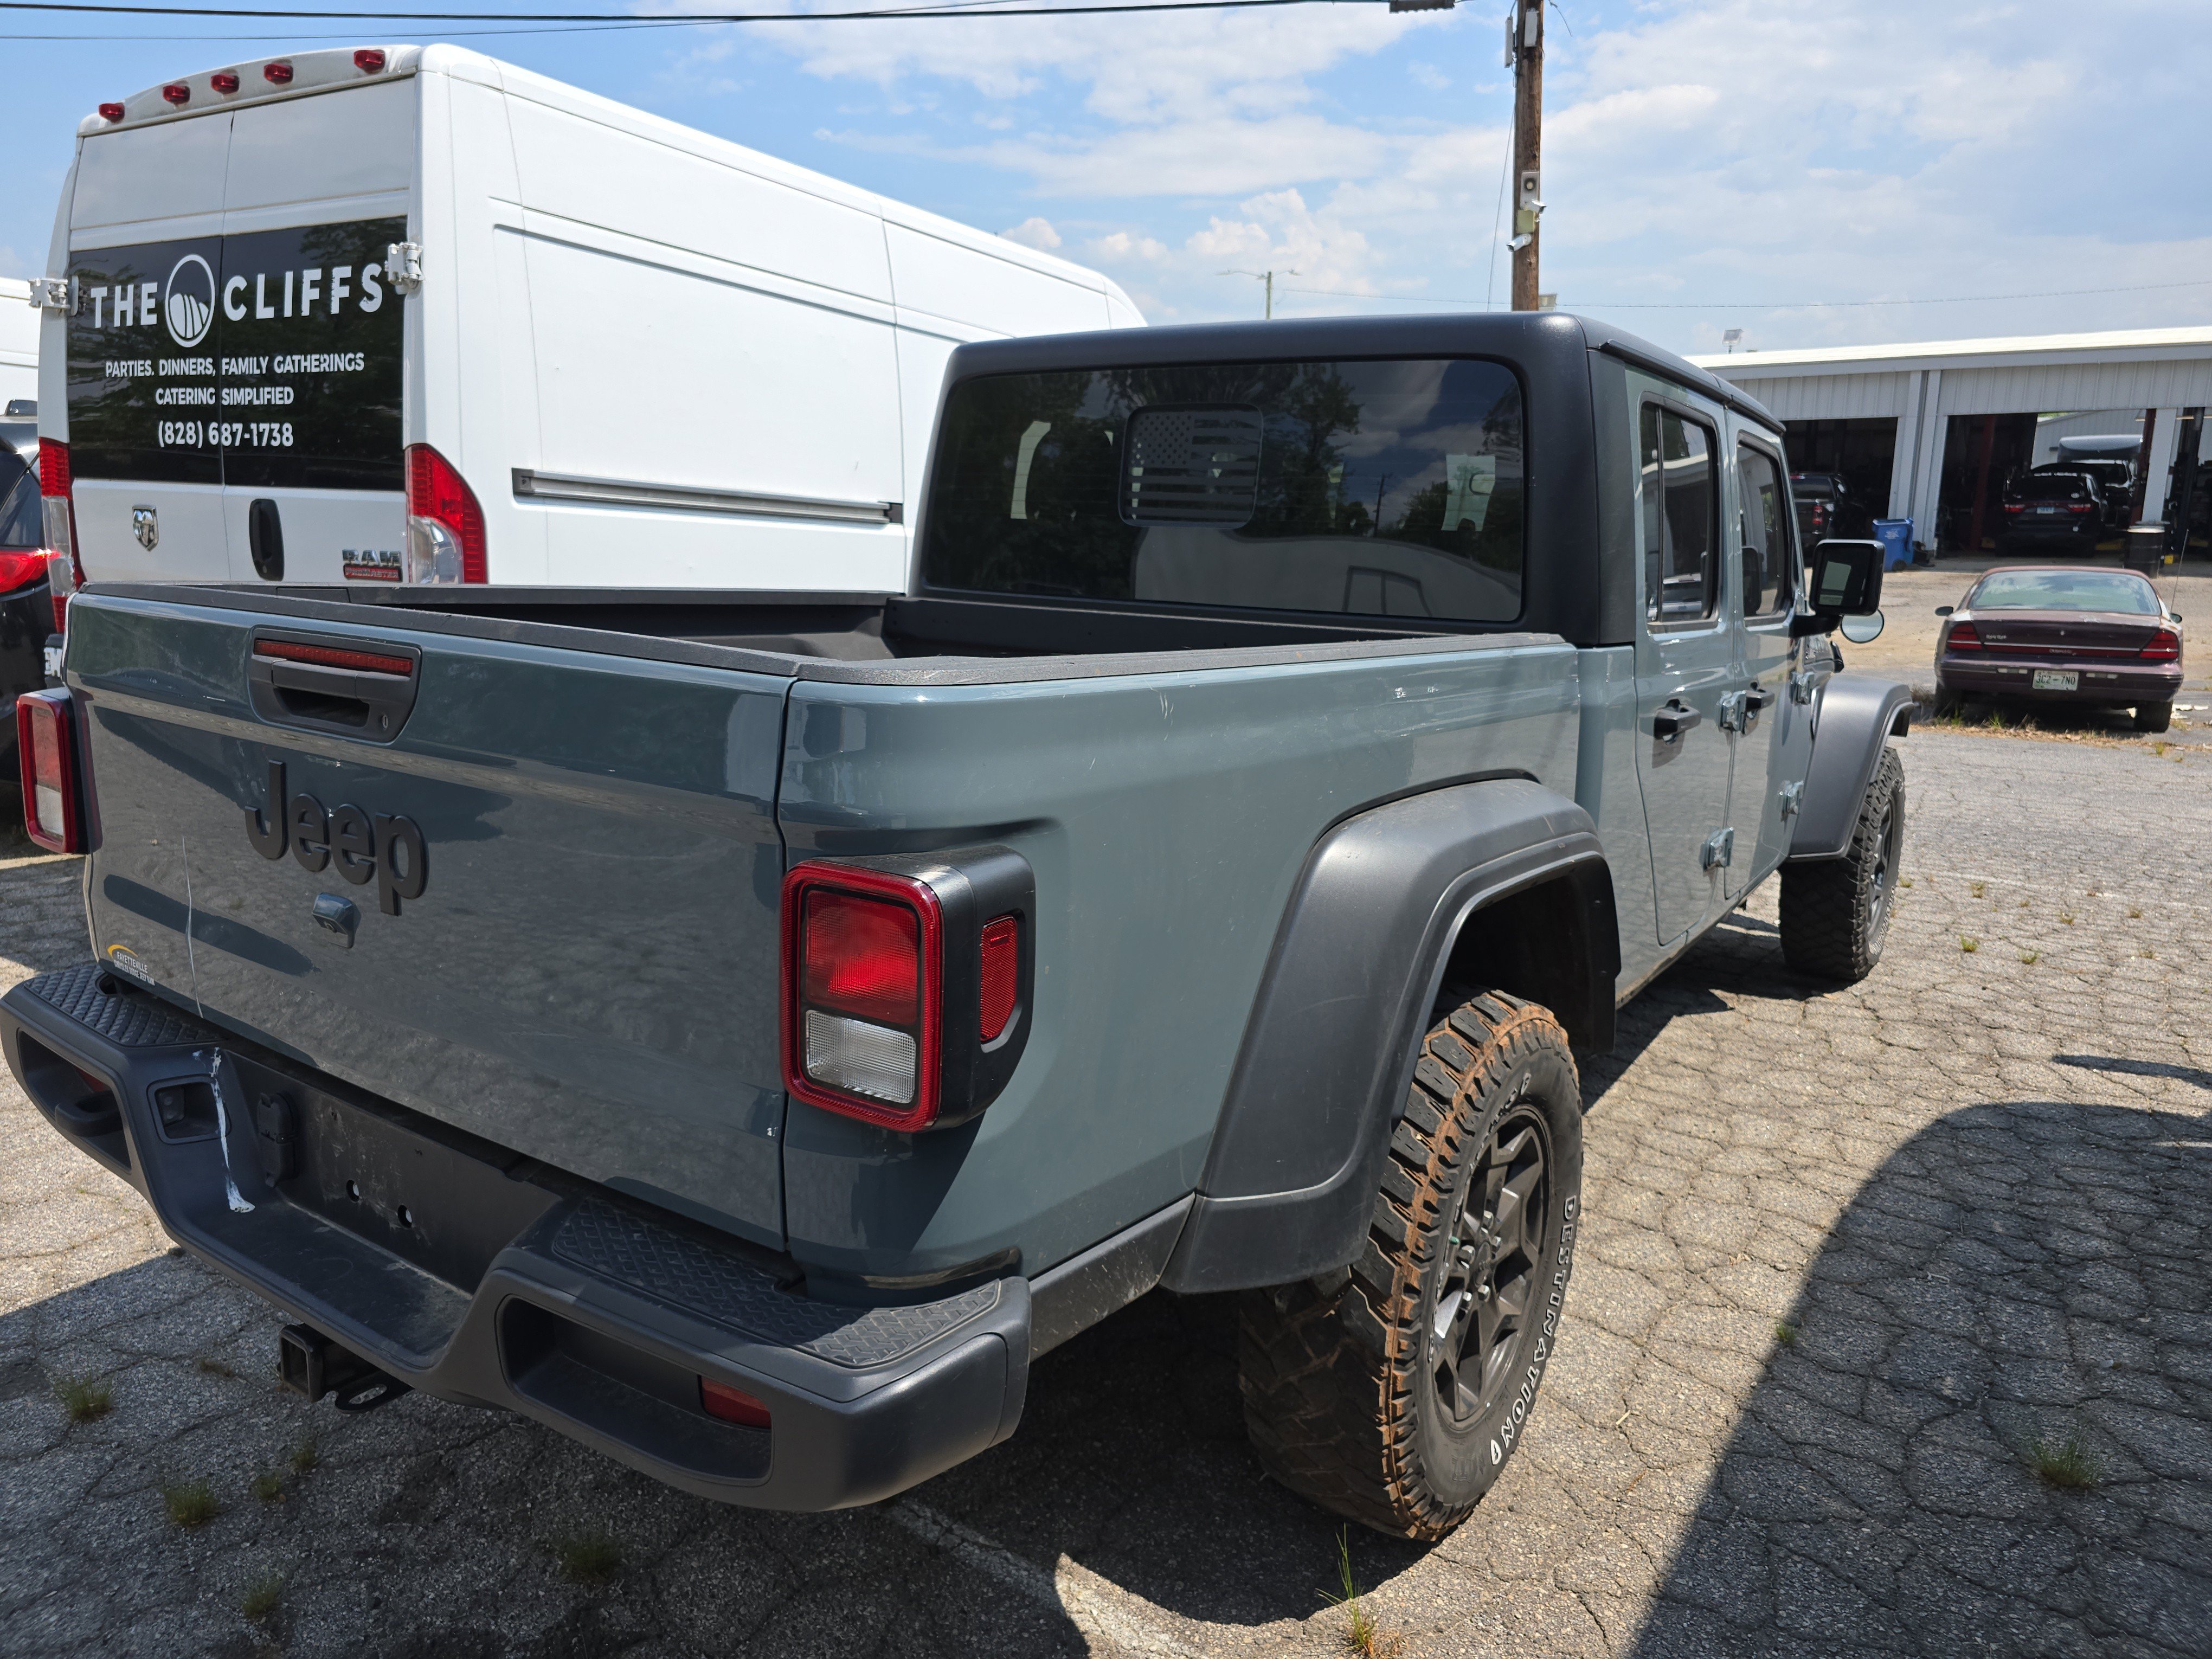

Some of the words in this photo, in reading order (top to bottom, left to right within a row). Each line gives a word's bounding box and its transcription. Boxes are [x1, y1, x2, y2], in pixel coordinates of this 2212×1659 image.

[90, 281, 159, 329] THE
[223, 262, 383, 322] CLIFFS
[159, 357, 216, 377] DINNERS,
[221, 356, 269, 376] FAMILY
[273, 352, 365, 374] GATHERINGS
[156, 387, 216, 406] CATERING
[221, 386, 294, 406] SIMPLIFIED
[158, 420, 203, 449] (828)
[208, 421, 294, 447] 687-1738
[342, 549, 403, 568] RAM
[245, 760, 430, 917] Jeep
[116, 951, 149, 974] FAYETTEVILLE
[1501, 1194, 1577, 1449] DESTINATION
